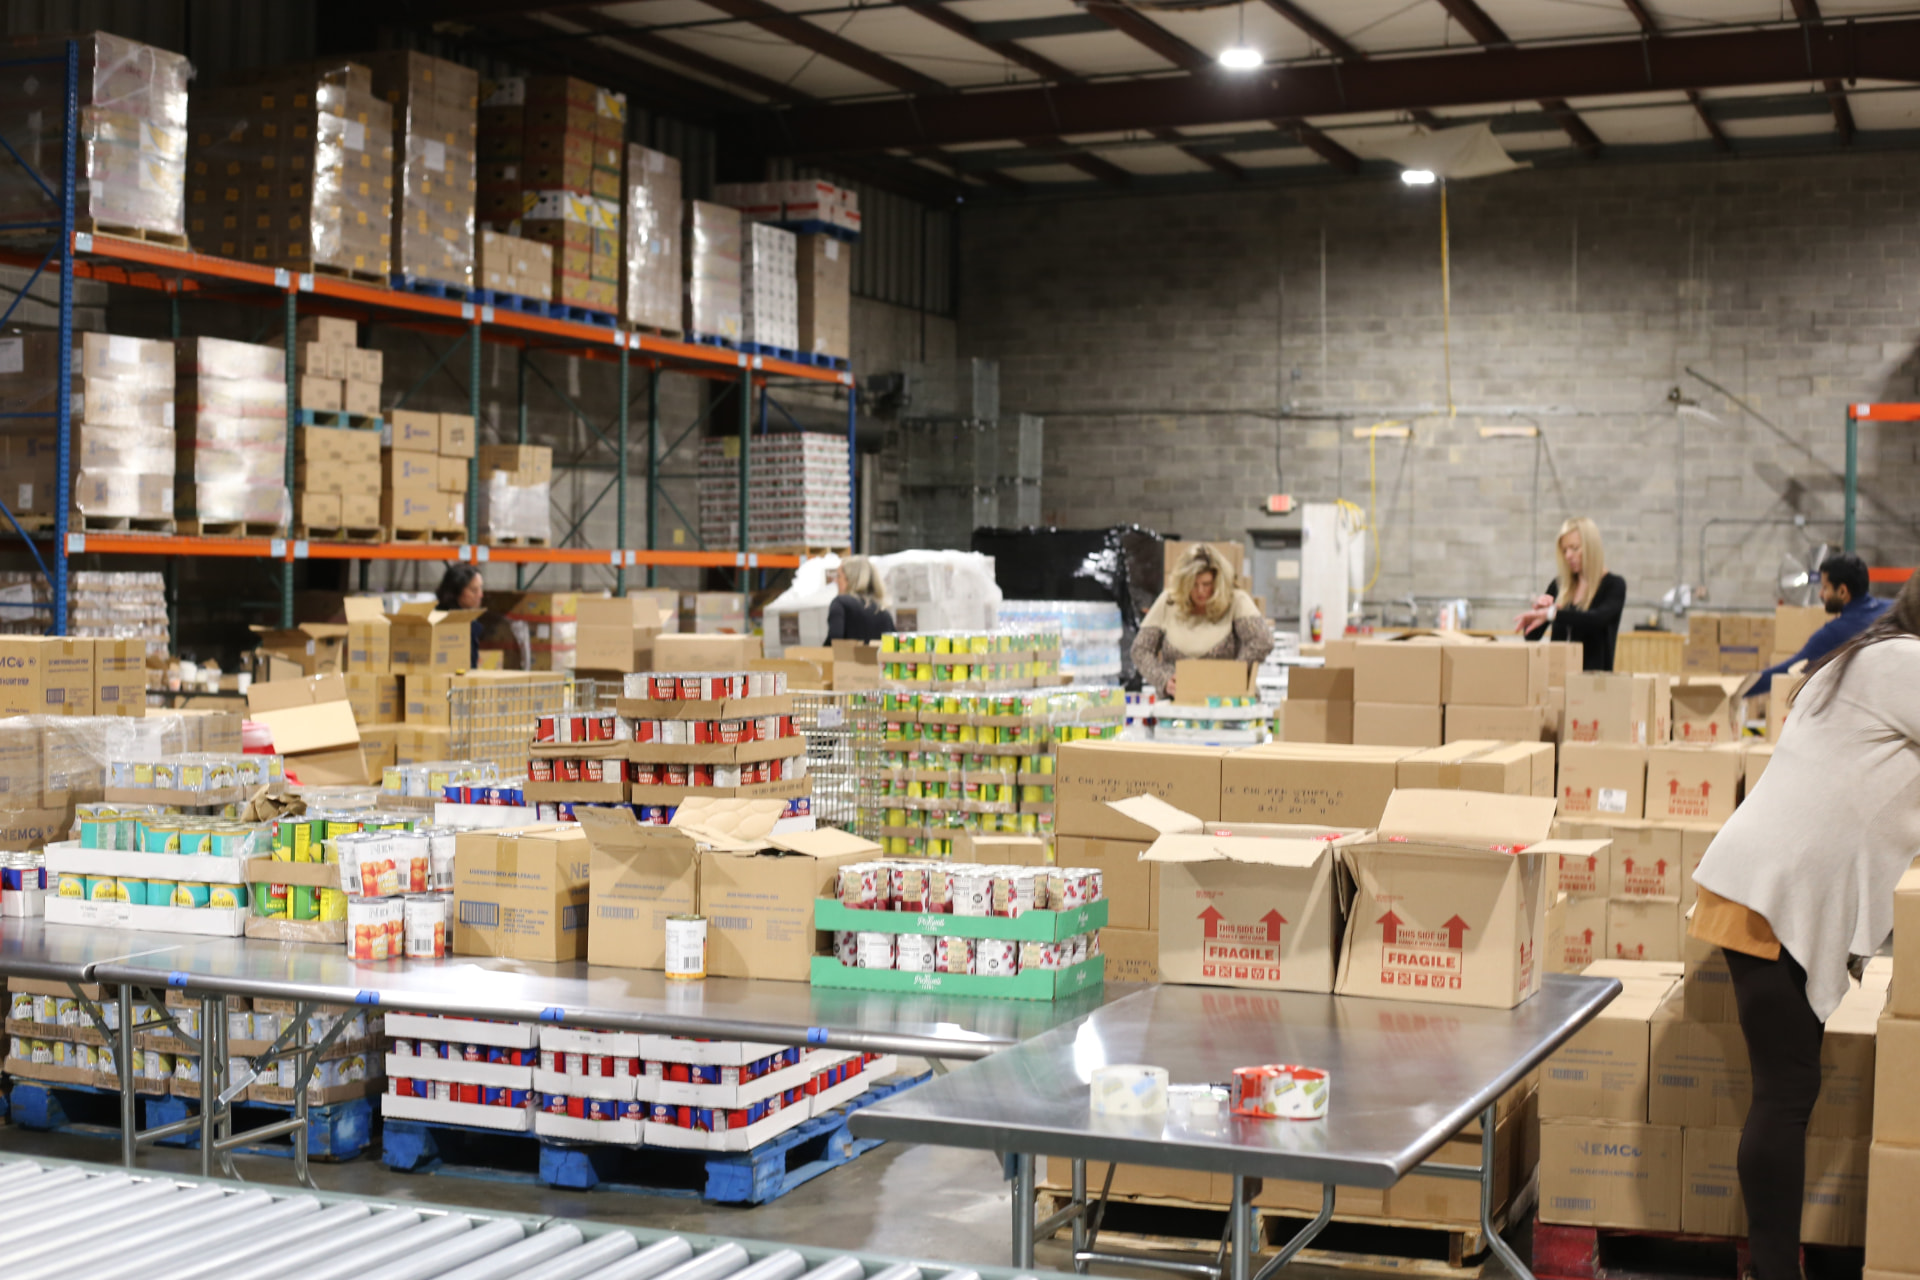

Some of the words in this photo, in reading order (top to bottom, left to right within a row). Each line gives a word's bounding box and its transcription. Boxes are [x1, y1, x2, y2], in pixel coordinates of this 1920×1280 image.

[1219, 924, 1235, 933] THIS
[1237, 925, 1254, 934] SIDE
[1255, 926, 1266, 935] UP
[1398, 929, 1415, 939] THIS
[1417, 930, 1434, 940] SIDE
[1437, 932, 1448, 941] UP
[1209, 945, 1274, 961] FRAGILE
[1388, 952, 1456, 969] FRAGILE
